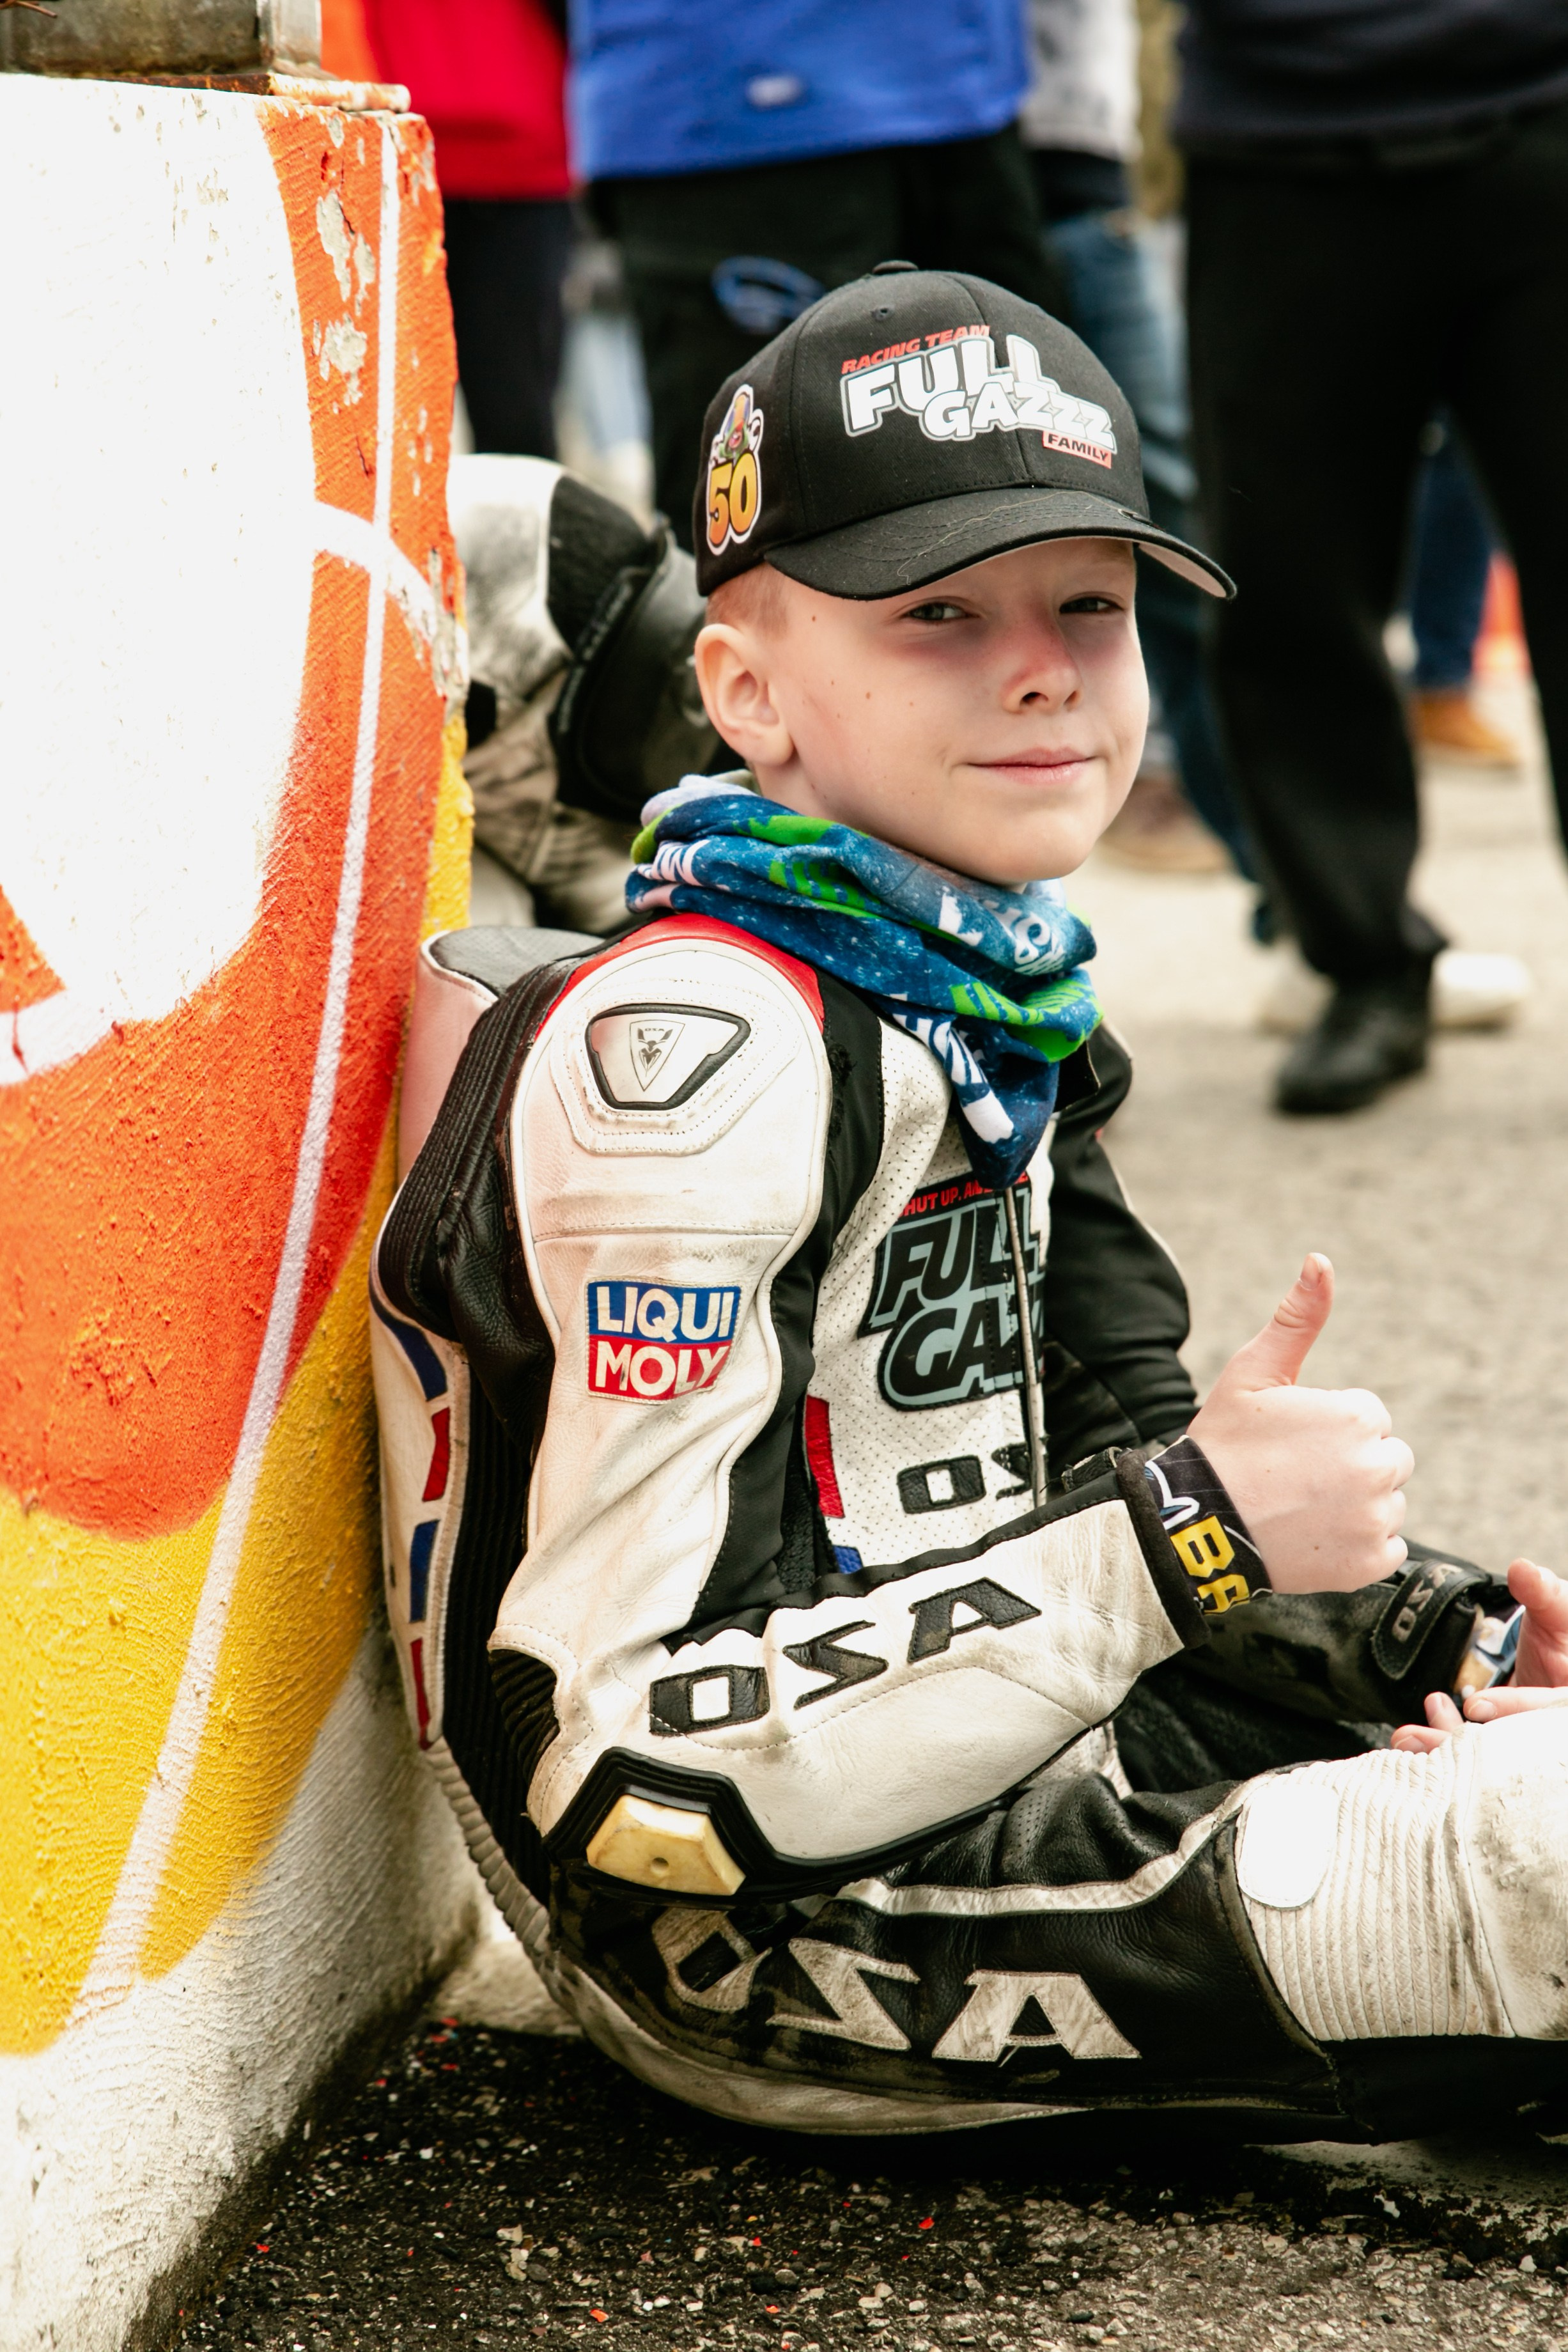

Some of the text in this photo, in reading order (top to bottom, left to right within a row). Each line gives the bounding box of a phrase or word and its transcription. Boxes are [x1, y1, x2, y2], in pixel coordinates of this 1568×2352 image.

[841, 325, 990, 375] RACING TEAM
[844, 334, 1059, 433] FULL
[922, 382, 1116, 451] GAZZZ
[1047, 432, 1110, 463] FAMILY
[708, 451, 759, 546] 50
[898, 1192, 938, 1217] HUT
[596, 1286, 734, 1342] LIQUI
[594, 1341, 730, 1396] MOLY
[896, 1442, 1033, 1514] OS
[649, 1577, 1043, 1736] OSA
[651, 1908, 1142, 2062] OSA
